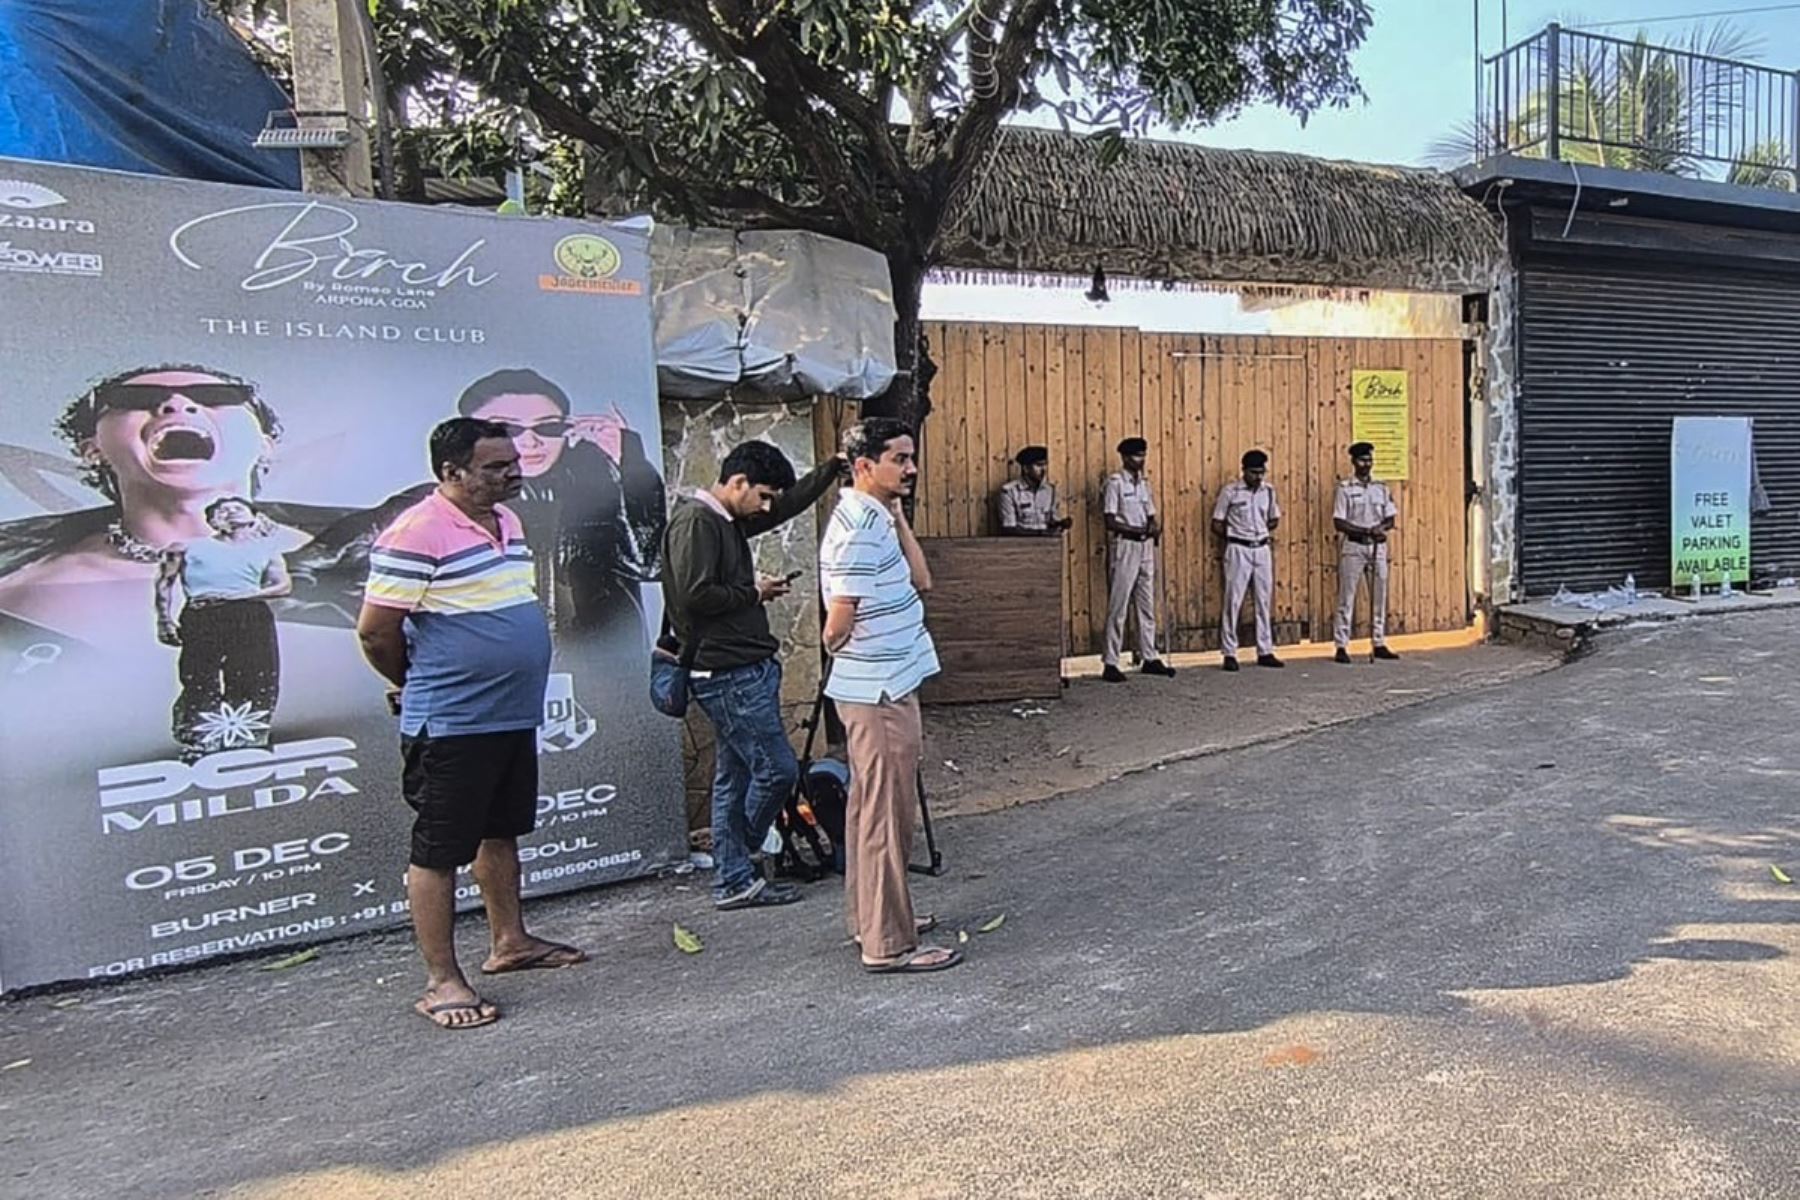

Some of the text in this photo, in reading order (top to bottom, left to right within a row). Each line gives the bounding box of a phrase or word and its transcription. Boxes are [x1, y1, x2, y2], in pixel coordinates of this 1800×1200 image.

[170, 200, 497, 290] Birch
[303, 281, 325, 292] By
[200, 318, 486, 343] THE ISLAND CLUB
[1694, 492, 1728, 507] FREE
[1691, 514, 1732, 529] VALET
[1682, 536, 1741, 550] PARKING
[1676, 556, 1747, 575] AVAILABLE
[102, 777, 359, 834] MILDA
[125, 832, 350, 890] 05 DEC
[517, 836, 599, 862] SOUL
[165, 876, 241, 900] FRIDAY
[261, 869, 285, 881] 10
[289, 862, 322, 876] PM
[151, 892, 317, 938] BURNER
[88, 957, 145, 979] FOR
[150, 915, 336, 968] RESERVATIONS
[352, 904, 386, 921] +91
